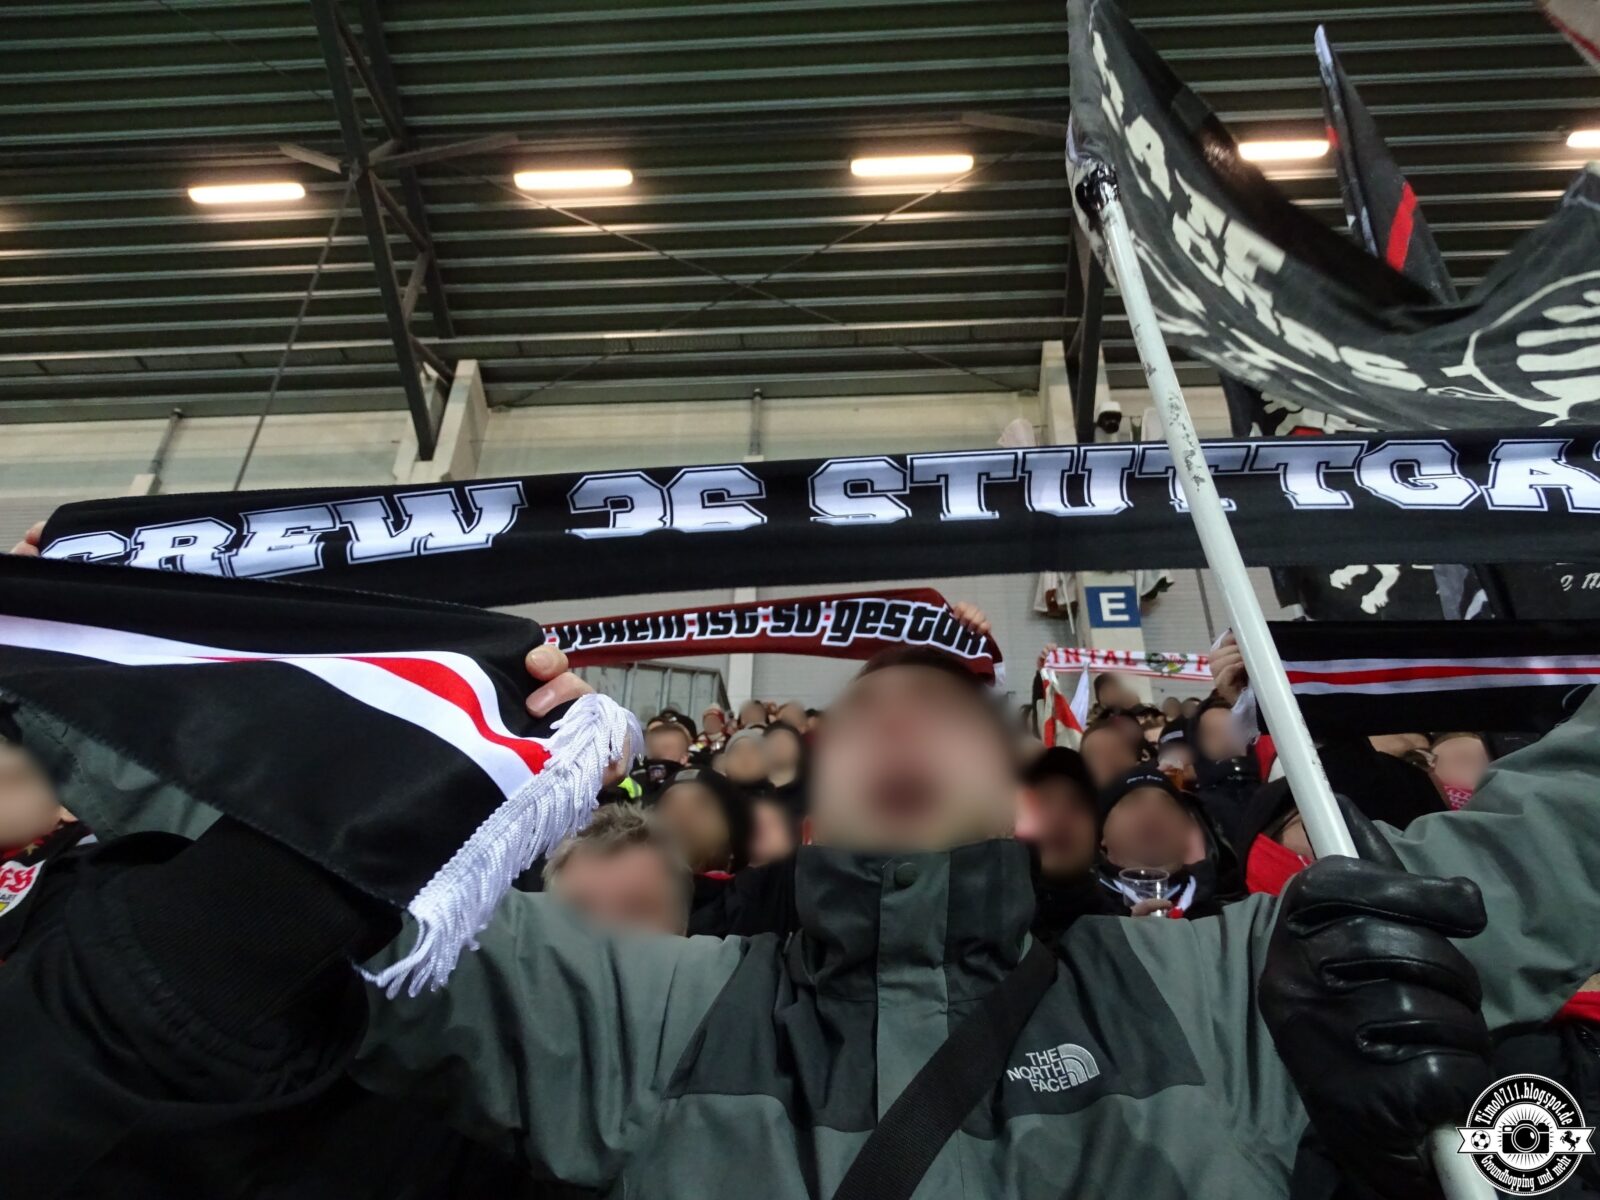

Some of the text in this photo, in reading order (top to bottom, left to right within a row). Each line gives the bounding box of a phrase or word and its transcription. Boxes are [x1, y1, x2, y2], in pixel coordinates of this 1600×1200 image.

[565, 464, 768, 539] 36
[807, 438, 1600, 525] STUTTGA
[1099, 592, 1130, 621] E
[1025, 1048, 1061, 1066] THE
[1006, 1061, 1066, 1081] NORTH
[1029, 1075, 1071, 1092] FACE
